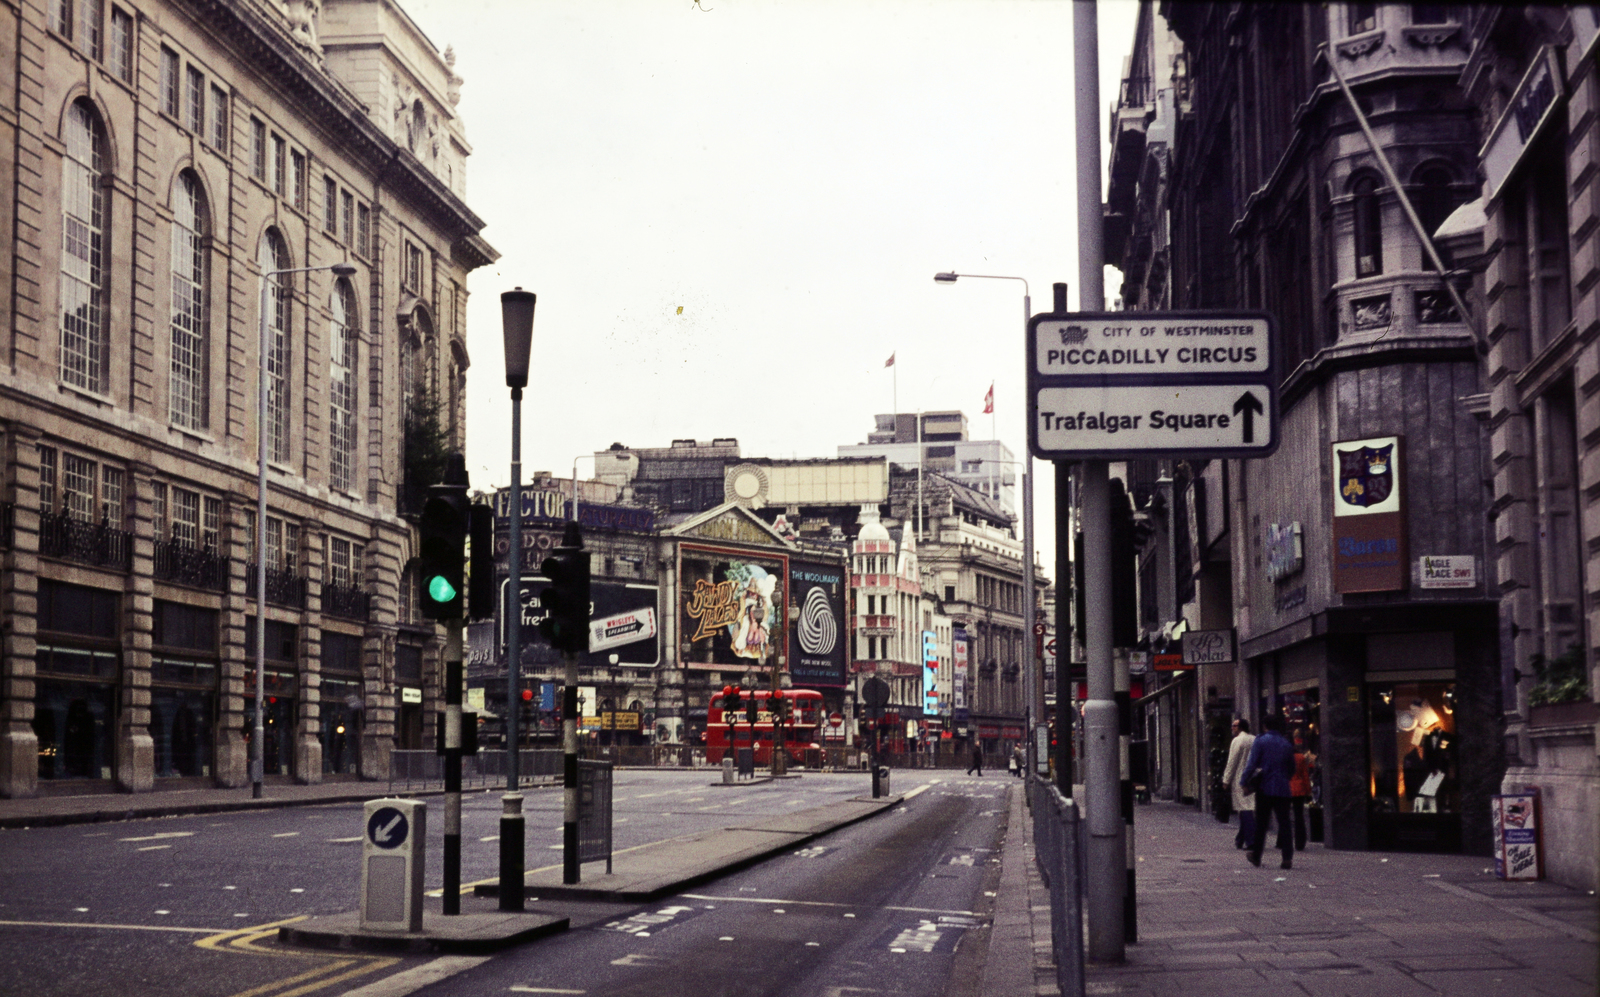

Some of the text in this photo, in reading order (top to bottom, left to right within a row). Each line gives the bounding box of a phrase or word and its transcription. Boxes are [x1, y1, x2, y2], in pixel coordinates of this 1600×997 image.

[1102, 325, 1254, 338] CITY OF WESTMINSTER
[1047, 347, 1257, 365] PICCADILLY CIRCUS
[1041, 410, 1230, 434] Trafalgar Square
[791, 570, 840, 584] THE WOOLMARK
[1425, 568, 1471, 579] PLACE SW1
[1511, 846, 1532, 864] SALE
[1513, 854, 1535, 875] HERE
